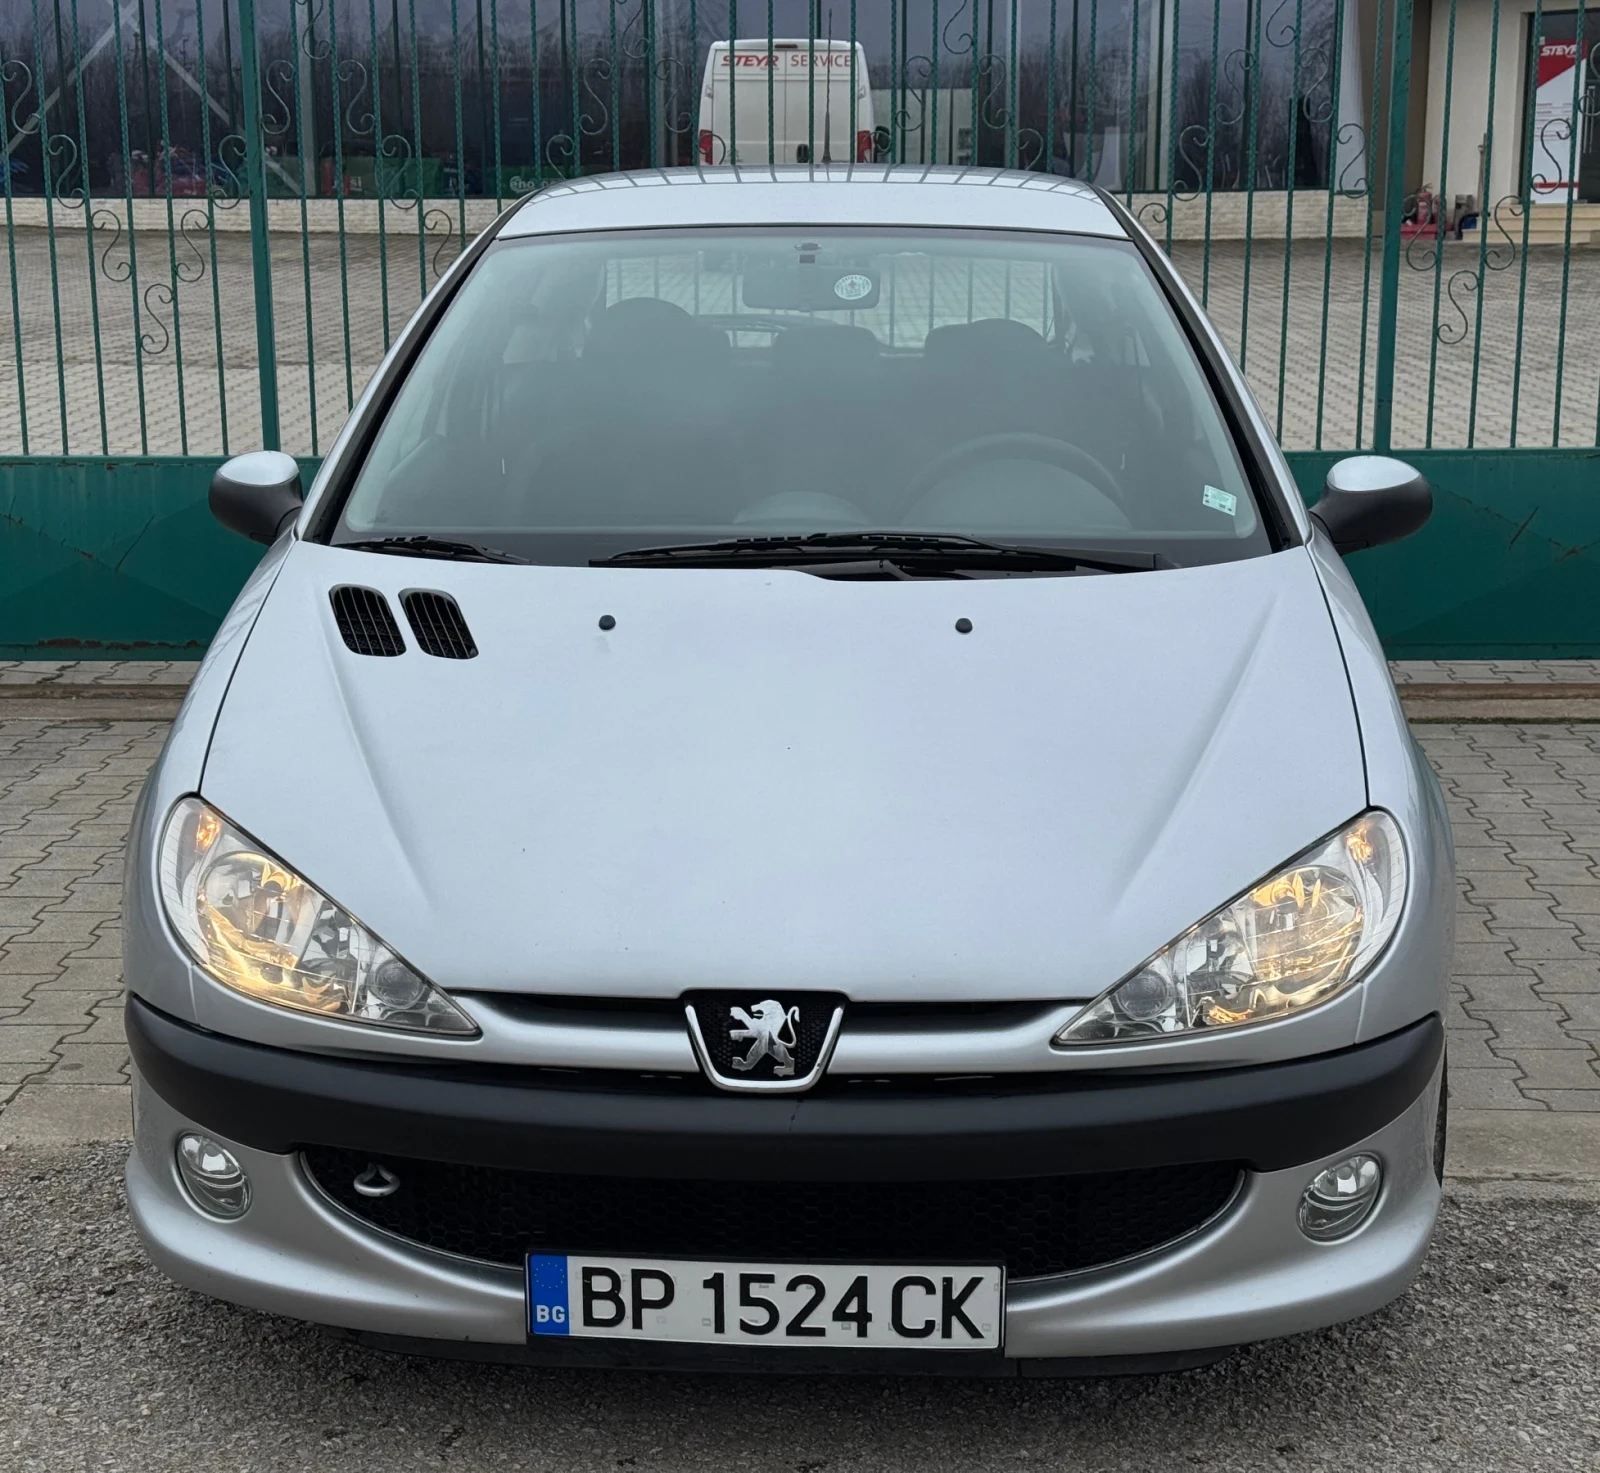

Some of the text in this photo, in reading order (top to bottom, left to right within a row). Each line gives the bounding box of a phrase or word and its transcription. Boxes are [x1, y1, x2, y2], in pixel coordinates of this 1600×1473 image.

[721, 54, 851, 67] STEYR SERVICE
[581, 1266, 985, 1339] BP 1524 CK
[536, 1304, 565, 1324] BG
